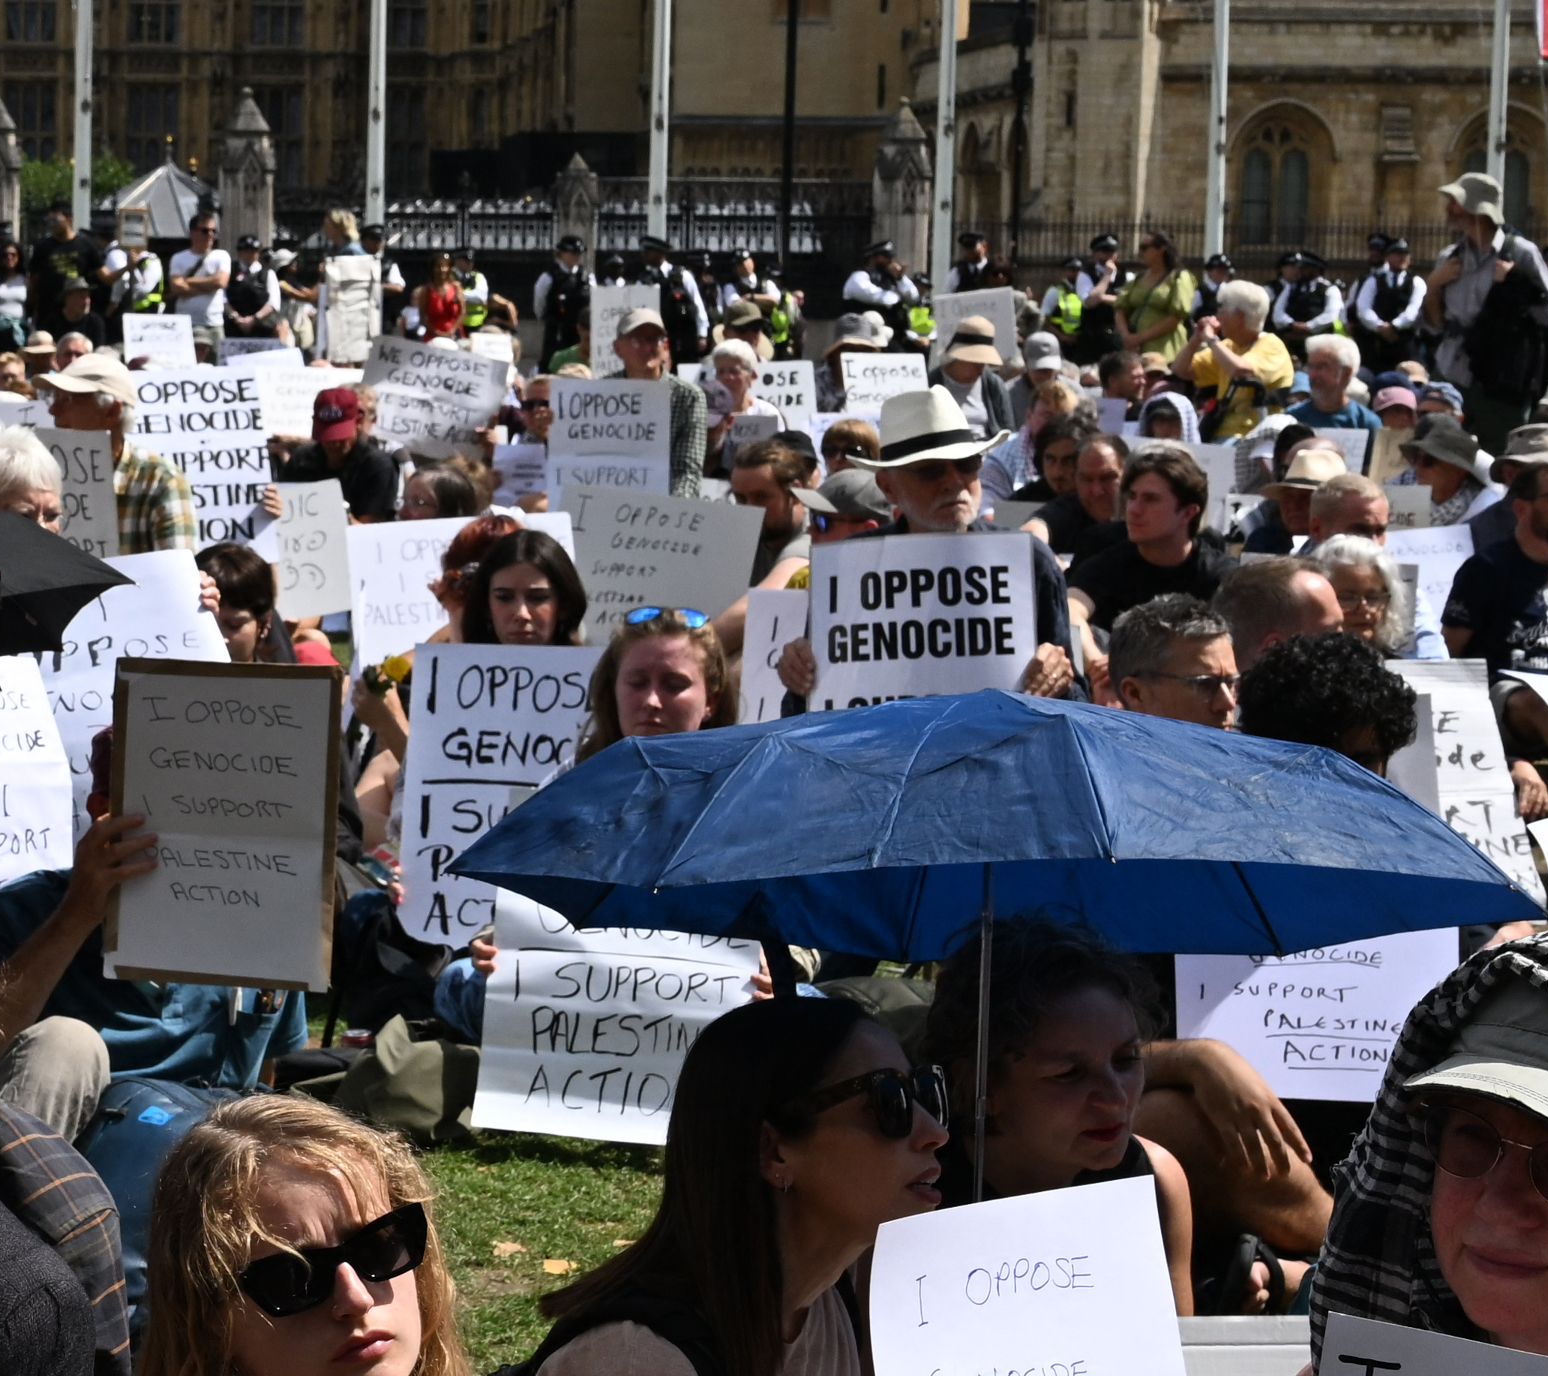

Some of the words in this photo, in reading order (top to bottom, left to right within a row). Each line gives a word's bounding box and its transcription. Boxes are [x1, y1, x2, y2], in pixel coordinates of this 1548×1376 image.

[379, 345, 402, 362] WE
[410, 351, 487, 376] OPPOSE
[387, 368, 480, 397] GENOCIDE
[863, 366, 921, 384] oppose
[138, 378, 258, 404] OPPOSE
[559, 393, 564, 420] I
[570, 393, 641, 417] OPPOSE
[568, 422, 656, 441] GENOCIDE
[572, 466, 652, 486] SUPPORT
[573, 496, 592, 533] I
[616, 504, 704, 531] OPPOSE
[611, 532, 701, 555] GENOCIDE
[830, 576, 837, 613] I
[861, 566, 1010, 610] OPPOSE
[828, 617, 1015, 663] GENOCIDE
[427, 657, 438, 714] I
[147, 698, 175, 721] I
[185, 700, 302, 729] OPPOSE
[149, 747, 297, 777] GENOCIDE
[180, 796, 292, 818] SUPPORT
[420, 795, 430, 838] I
[170, 882, 260, 907] ACTION
[515, 960, 520, 1000] I
[552, 963, 739, 1003] SUPPORT
[1234, 983, 1357, 1002] SUPPORT
[1264, 1009, 1400, 1034] PALESTINE
[1284, 1041, 1387, 1063] ACTION
[916, 1275, 928, 1327] I
[966, 1256, 1093, 1305] OPPOSE
